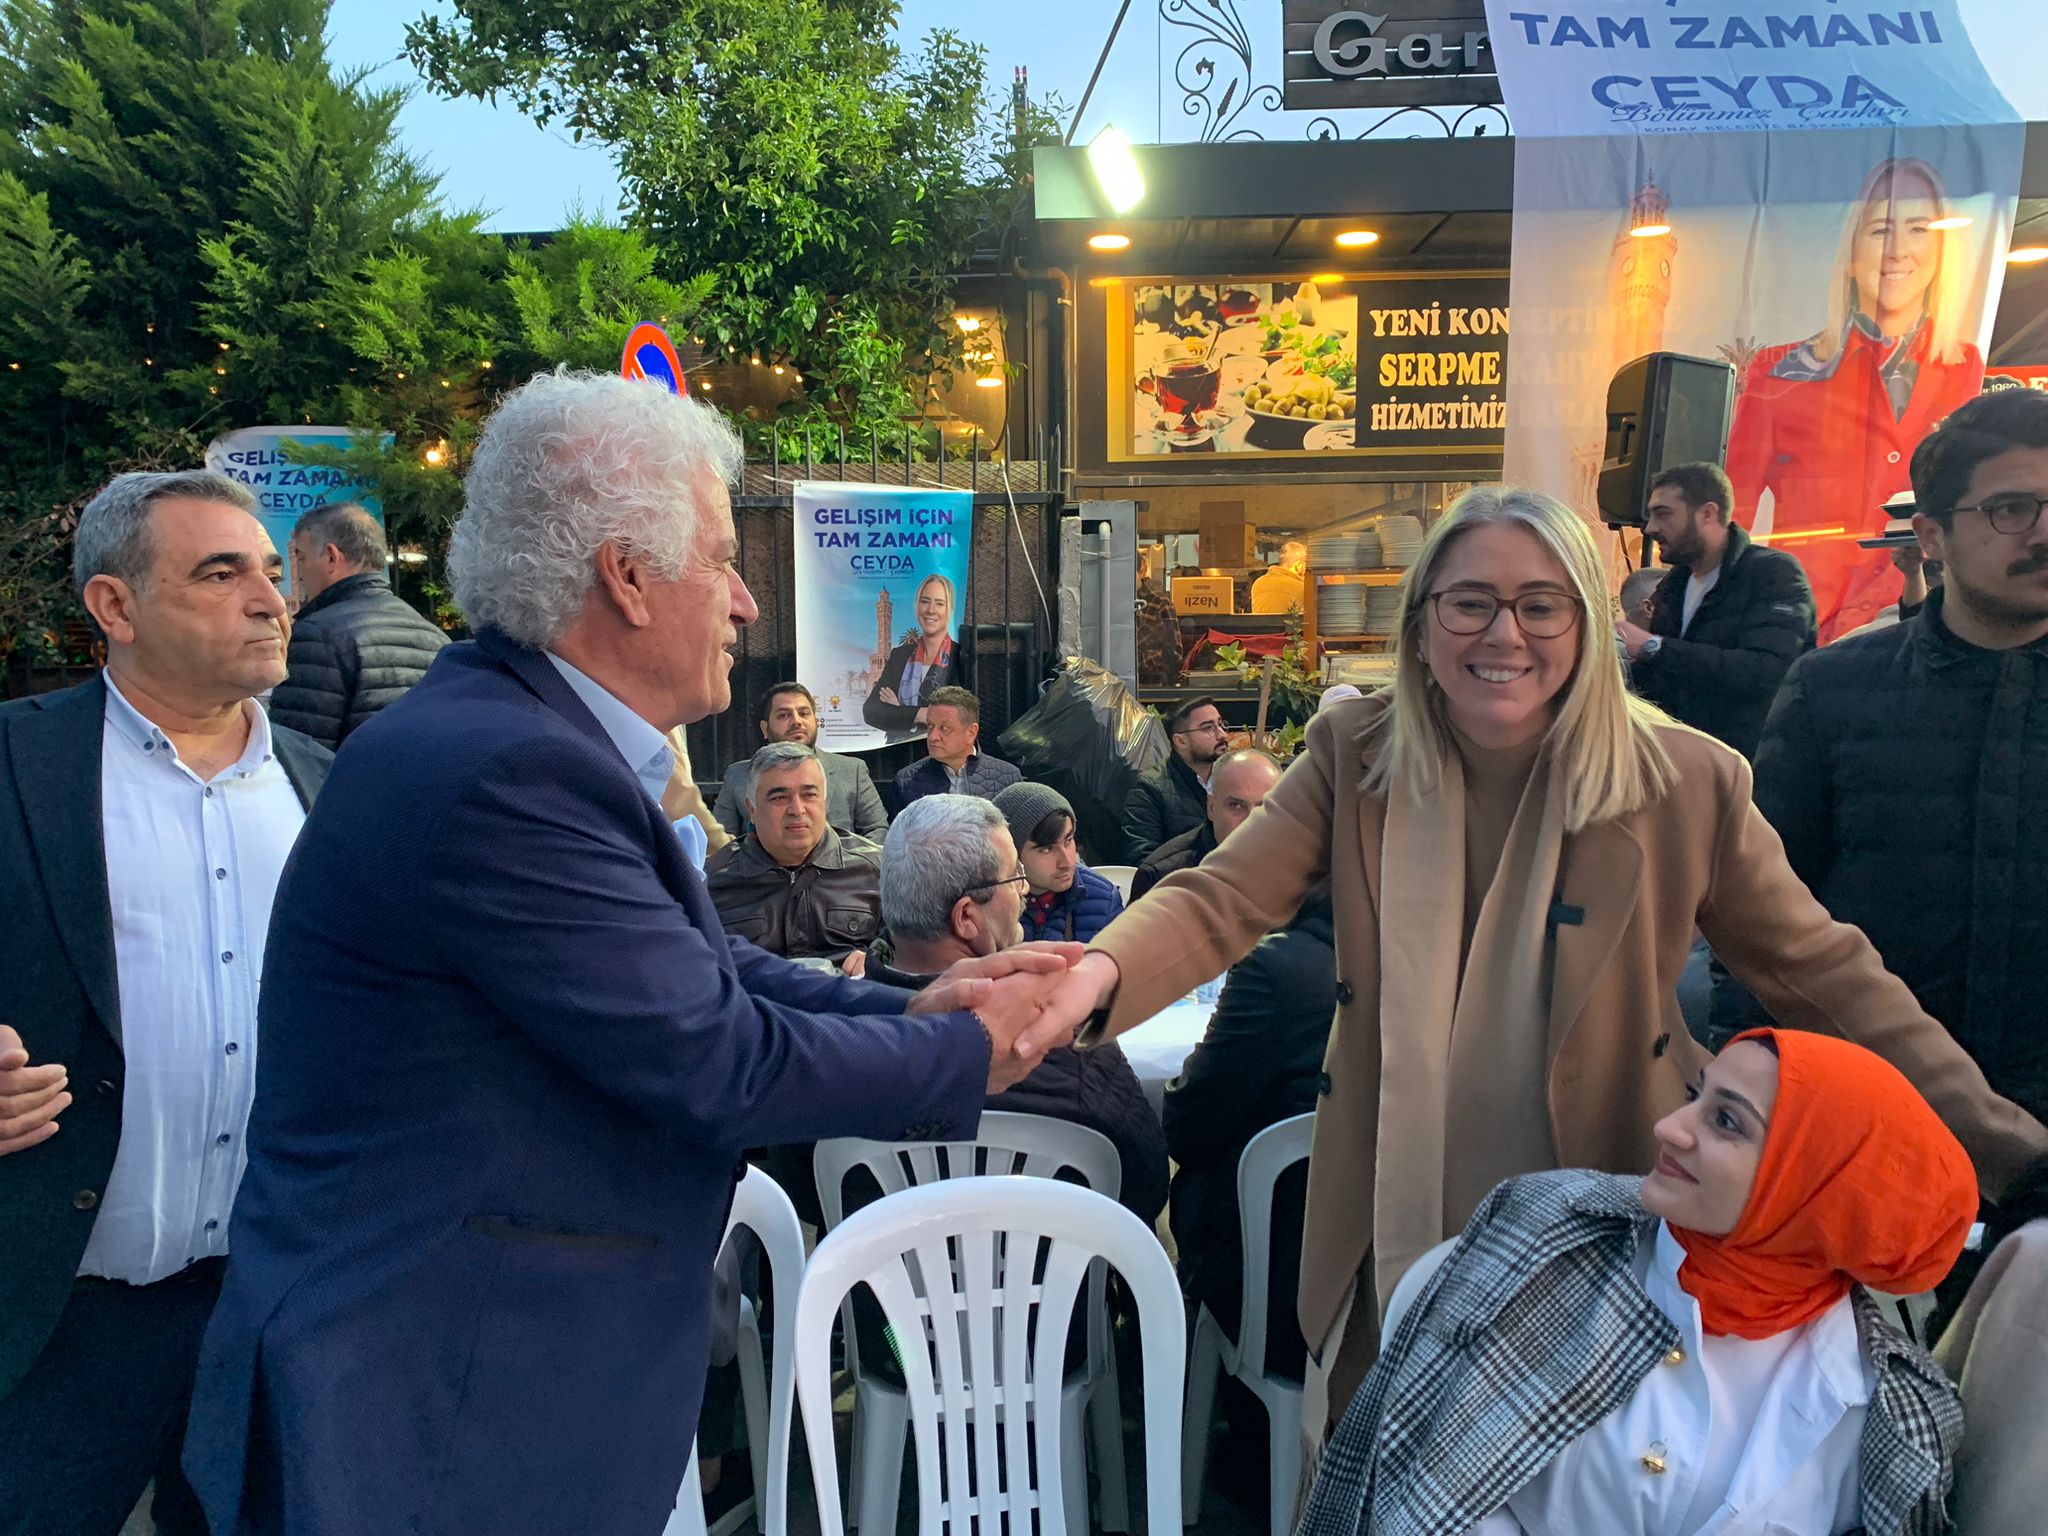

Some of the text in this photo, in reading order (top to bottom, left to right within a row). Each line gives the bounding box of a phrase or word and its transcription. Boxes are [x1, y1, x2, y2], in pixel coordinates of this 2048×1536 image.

[1510, 11, 1943, 49] TAM ZAMANI
[1591, 74, 1907, 111] CEYDA
[1610, 102, 1773, 122] Bölünmez
[1370, 301, 1441, 337] YENİ
[1379, 351, 1500, 387] SERPME
[1371, 393, 1507, 431] HİZMETİMİZ
[227, 449, 289, 467] GELİŞ
[225, 467, 272, 486] TAM
[259, 492, 328, 509] CEYDA
[814, 508, 954, 528] GELİŞİM İÇİN
[814, 532, 953, 548] TAM ZAMANI
[850, 555, 915, 570] CEYDA
